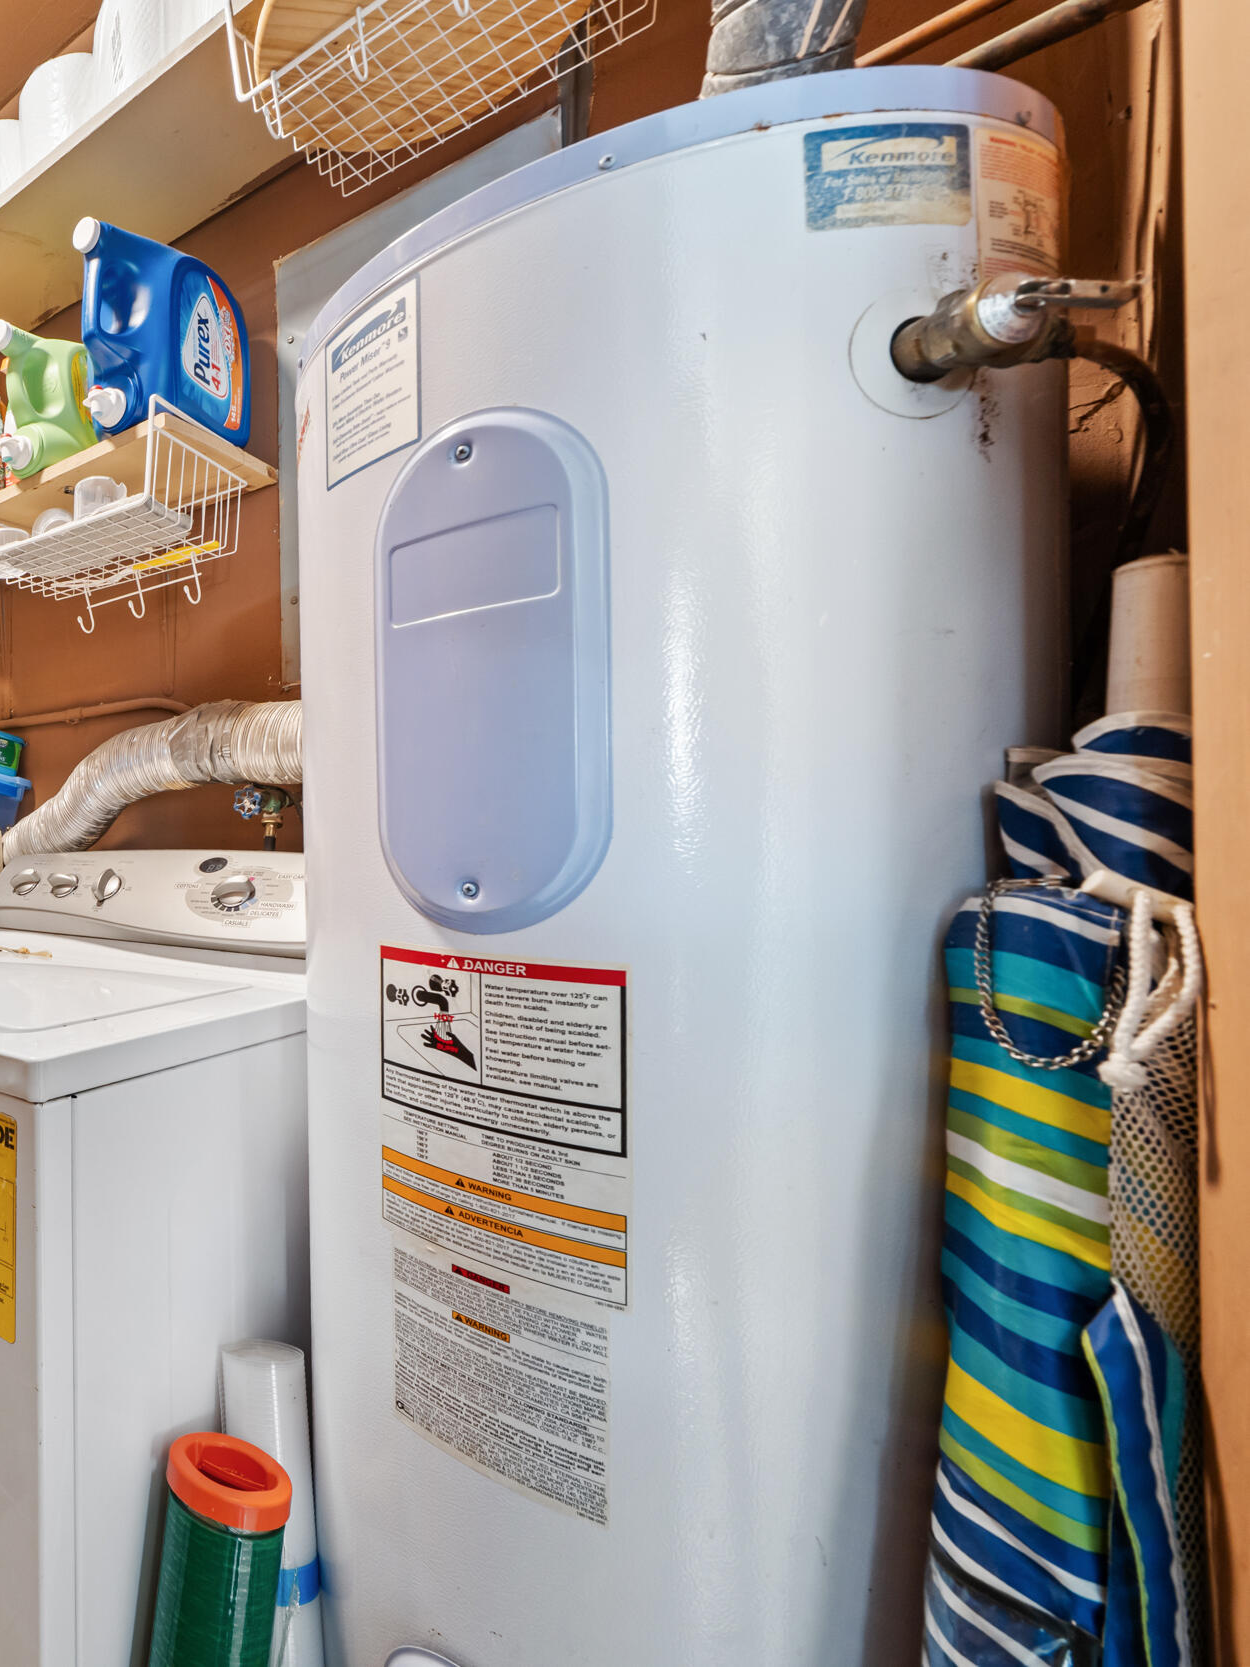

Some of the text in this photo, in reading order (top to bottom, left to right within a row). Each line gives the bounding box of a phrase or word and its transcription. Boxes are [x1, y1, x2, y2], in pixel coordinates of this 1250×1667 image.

[341, 311, 405, 363] Kenmore
[194, 313, 210, 385] Purex
[462, 959, 526, 976] DANGER
[506, 986, 548, 996] temperature
[532, 996, 553, 1004] burns
[556, 999, 588, 1008] instantly
[434, 1013, 454, 1022] HOT
[485, 1011, 515, 1020] Children,
[518, 1015, 548, 1024] disabled
[566, 1021, 592, 1030] elderly
[493, 1020, 518, 1029] highest
[545, 1026, 566, 1035] being
[568, 1030, 601, 1038] scalded.
[485, 1036, 498, 1044] ting
[500, 1038, 542, 1050] temperature
[577, 1049, 603, 1057] heater.
[500, 1030, 537, 1041] instruction
[539, 1036, 566, 1045] manual
[569, 1038, 593, 1048] before
[486, 1055, 522, 1066] showering.
[522, 1051, 545, 1061] before
[547, 1057, 575, 1067] bathing
[486, 1065, 528, 1078] Temperature
[530, 1073, 557, 1083] limiting
[560, 1078, 584, 1086] valves
[486, 1074, 517, 1084] available,
[534, 1082, 563, 1091] manual.
[468, 1182, 511, 1200] WARNING
[459, 1211, 523, 1237] ADVERTENCIA
[465, 1317, 508, 1341] WARNING
